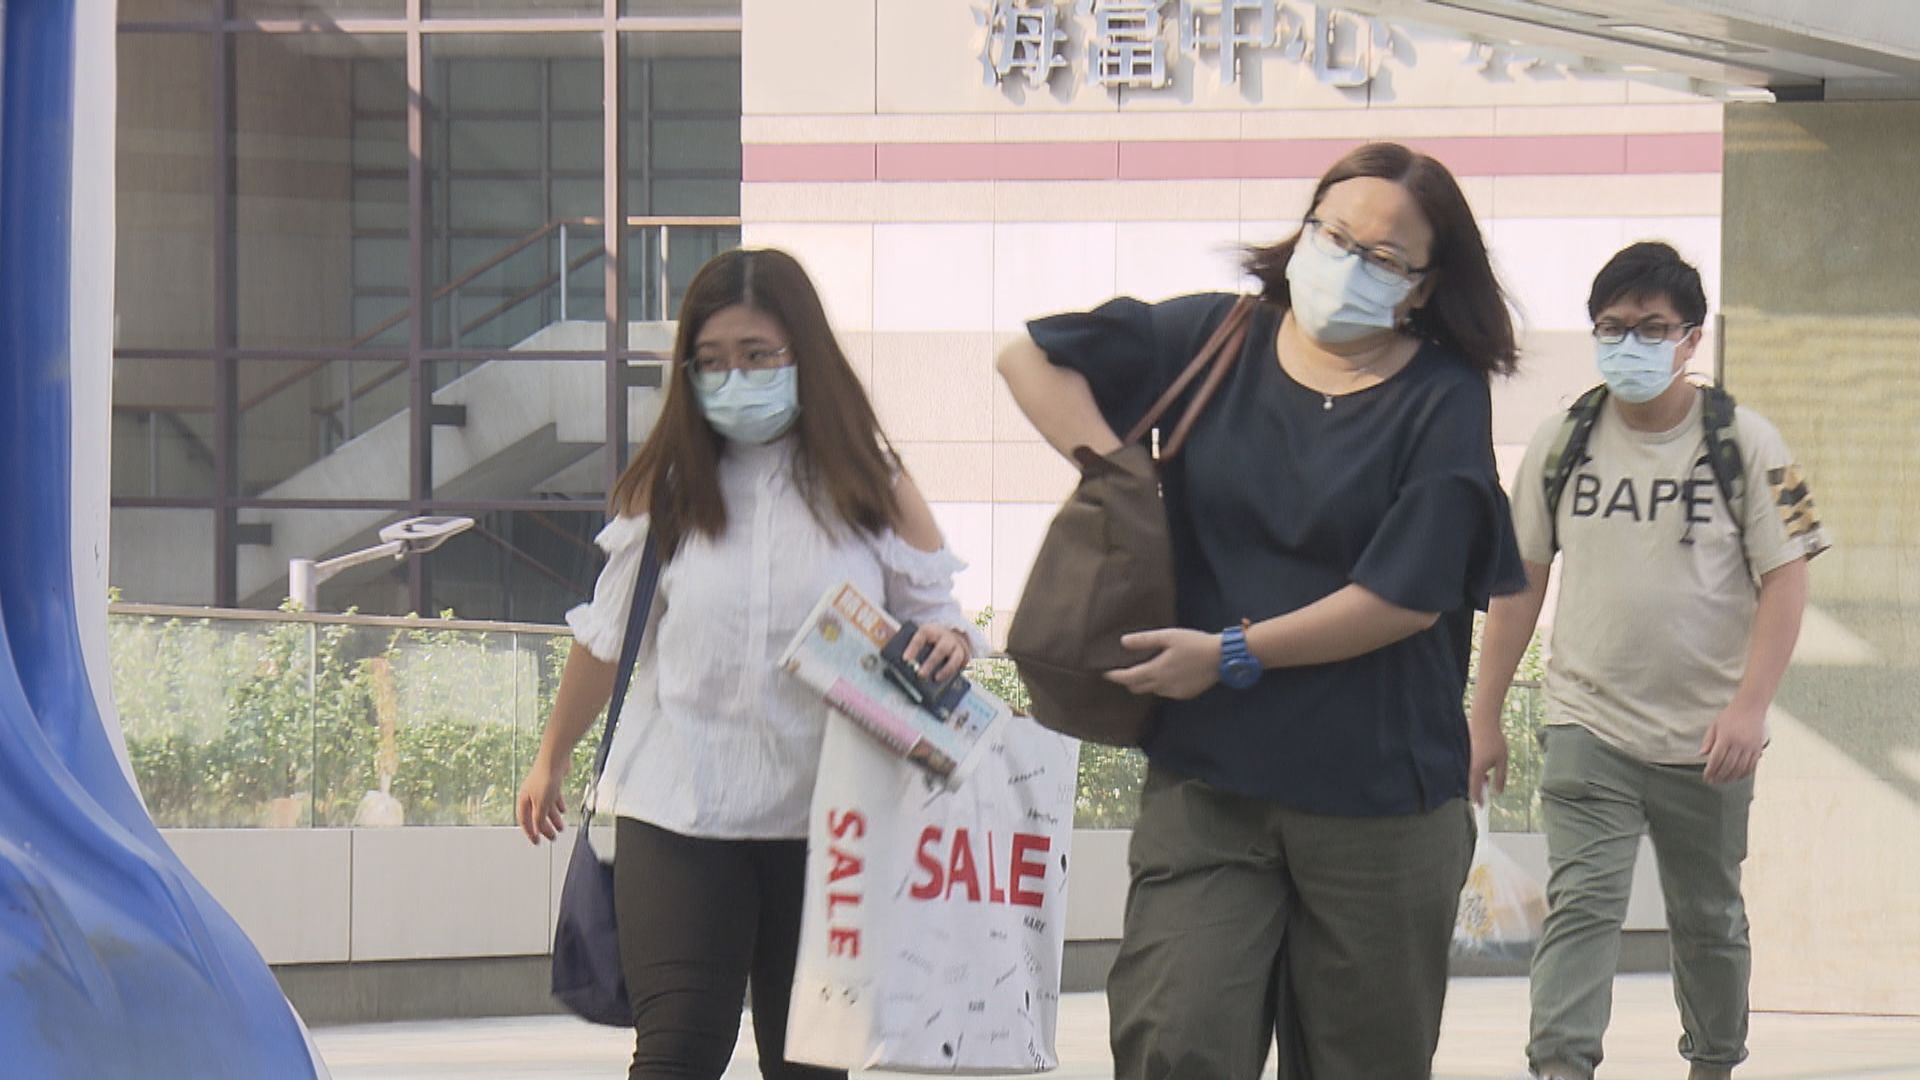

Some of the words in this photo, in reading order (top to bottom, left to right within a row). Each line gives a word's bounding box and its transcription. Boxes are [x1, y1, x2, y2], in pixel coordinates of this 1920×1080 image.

[973, 0, 1390, 87] 海富中心
[1572, 474, 1714, 523] BAPE
[826, 808, 865, 958] SALE
[910, 825, 1050, 908] SALE
